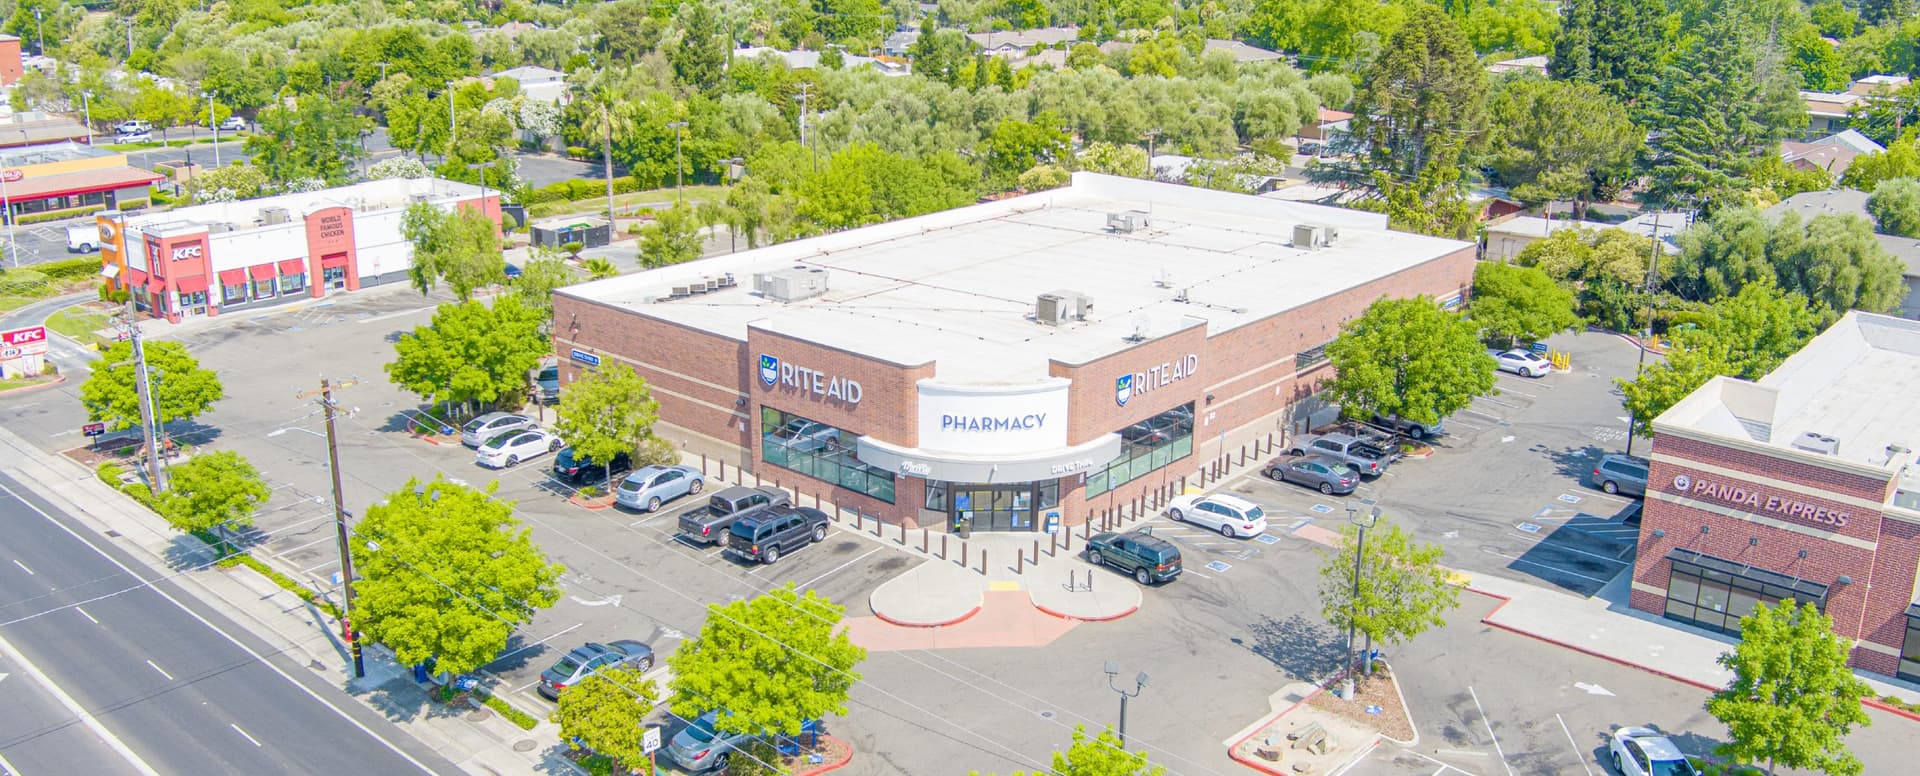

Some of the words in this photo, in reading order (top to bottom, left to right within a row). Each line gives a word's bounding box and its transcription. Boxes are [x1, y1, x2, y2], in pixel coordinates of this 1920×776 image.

[320, 215, 342, 223] WORLD
[320, 223, 343, 231] FAMOUS
[320, 230, 345, 238] CHICKEN
[171, 246, 202, 262] KFC
[13, 329, 43, 343] KFC
[781, 361, 825, 395] RITE
[827, 375, 863, 403] AID
[1134, 362, 1171, 396] RITE
[1172, 354, 1198, 381] AID
[942, 413, 1047, 432] PHARMACY
[1693, 480, 1760, 507] PANDA
[1764, 496, 1849, 527] EXPRESS
[646, 739, 658, 749] 40
